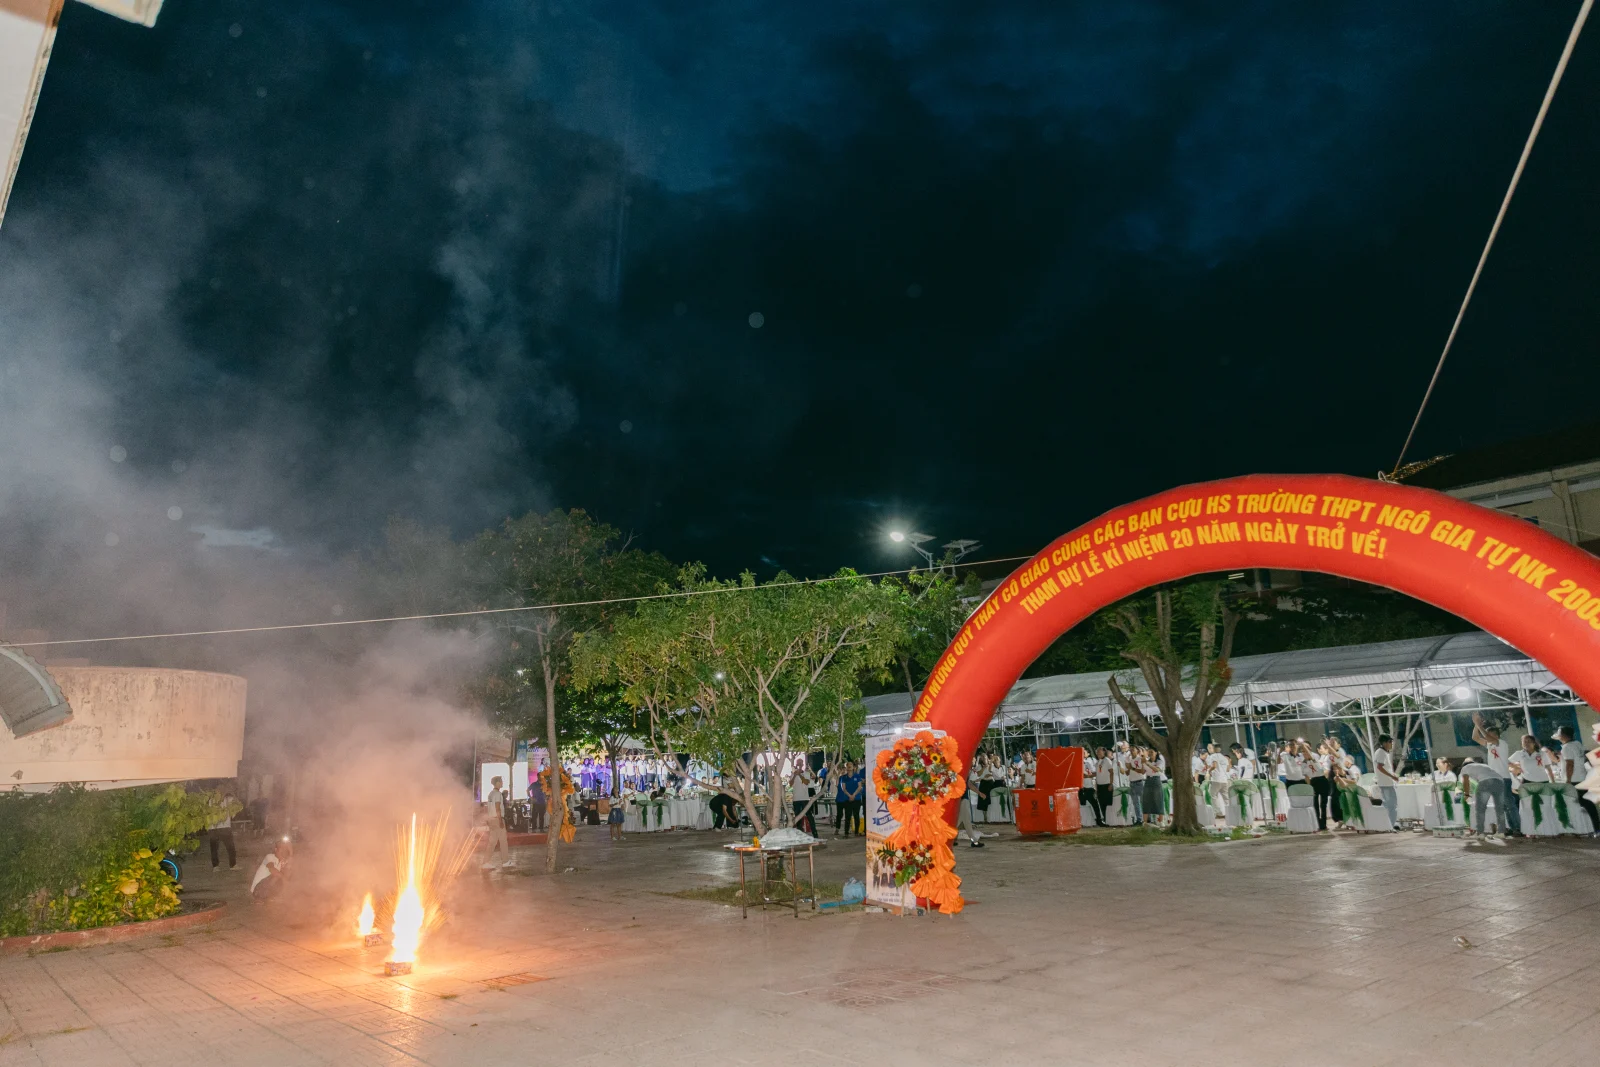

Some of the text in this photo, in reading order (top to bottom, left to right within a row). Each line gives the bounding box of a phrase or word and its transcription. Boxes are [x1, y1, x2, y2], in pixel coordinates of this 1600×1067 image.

[914, 694, 934, 722] HÀO
[928, 653, 957, 697] MỪNG
[1001, 579, 1020, 603] CÔ
[1019, 557, 1050, 588] GIÁO
[1052, 534, 1091, 566] CÙNG
[1093, 519, 1125, 545] CÁC
[1128, 507, 1163, 532] BẠN
[1166, 498, 1203, 523] CỰU
[1206, 494, 1232, 515] HS
[1236, 488, 1317, 514] TRƯỜNG
[1320, 495, 1377, 522] THPT
[1376, 503, 1432, 535] NGÔ
[1430, 520, 1476, 551] GIA
[1475, 536, 1520, 570] TỰ
[1508, 553, 1557, 589] NK
[1020, 518, 1387, 615] THAM DỰ LỄ KỈ NIỆM 20 NĂM NGÀY TRỞ VỀ!
